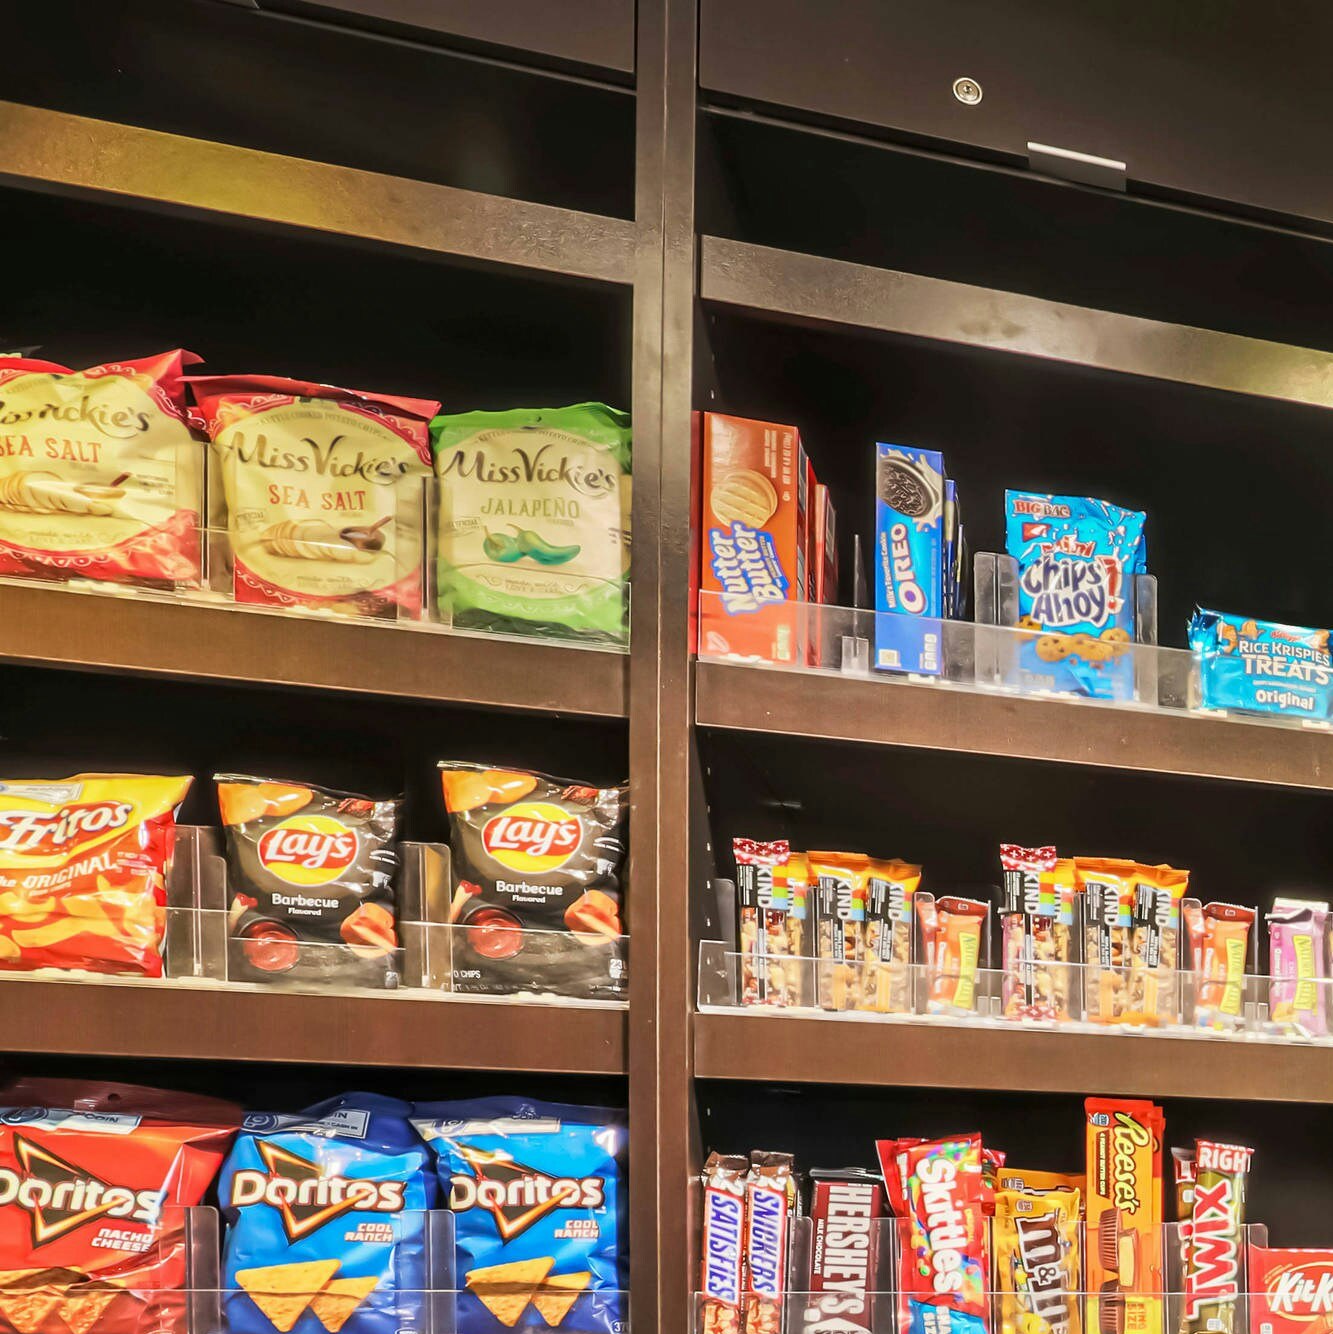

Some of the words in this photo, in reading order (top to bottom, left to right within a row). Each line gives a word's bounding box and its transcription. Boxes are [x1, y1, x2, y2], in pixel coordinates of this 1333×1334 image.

[45, 437, 102, 464] SALT
[223, 431, 309, 474] Miss
[301, 435, 411, 486] Vickie's
[441, 450, 521, 483] Miss
[512, 444, 616, 498] Vickie's
[268, 484, 310, 509] SEA
[321, 490, 366, 511] SALT
[480, 497, 580, 519] JALAPEÑO
[1014, 500, 1041, 515] BIG
[1042, 503, 1071, 518] BAG
[711, 531, 758, 614] Nutter
[733, 522, 785, 604] Butter
[889, 522, 928, 614] OREO
[1239, 640, 1269, 654] RICE
[1271, 643, 1330, 667] KRISPIES
[1242, 654, 1330, 685] TREATS
[1256, 688, 1314, 711] Original
[0, 803, 133, 851] Fritos
[489, 815, 577, 856] Lay's
[265, 829, 354, 869] Lay's
[22, 852, 119, 889] ORIGINAL
[495, 880, 563, 897] Barbecue
[757, 865, 773, 909] KIND
[271, 893, 339, 909] Barbecue
[837, 879, 853, 921] KIND
[888, 882, 905, 922] KIND
[1024, 871, 1040, 914] KIND
[1104, 884, 1120, 926] KIND
[1155, 890, 1172, 927] KIND
[1114, 1111, 1151, 1215] Reese's
[235, 1172, 405, 1212] Doritos
[450, 1176, 605, 1212] Doritos
[91, 1237, 151, 1253] CHEESE
[98, 1228, 153, 1244] NACHO
[344, 1231, 393, 1243] RANCH
[357, 1223, 393, 1233] COOL
[554, 1229, 600, 1240] RANCH
[565, 1221, 600, 1230] COOL
[750, 1191, 780, 1295] SNICKERS
[814, 1218, 825, 1235] MILK
[916, 1158, 967, 1294] Skittles
[708, 1194, 739, 1304] SATISFIES
[813, 1235, 825, 1275] CHOCOLATE
[819, 1185, 873, 1316] HERSHEY'S
[1186, 1180, 1238, 1319] TWIX
